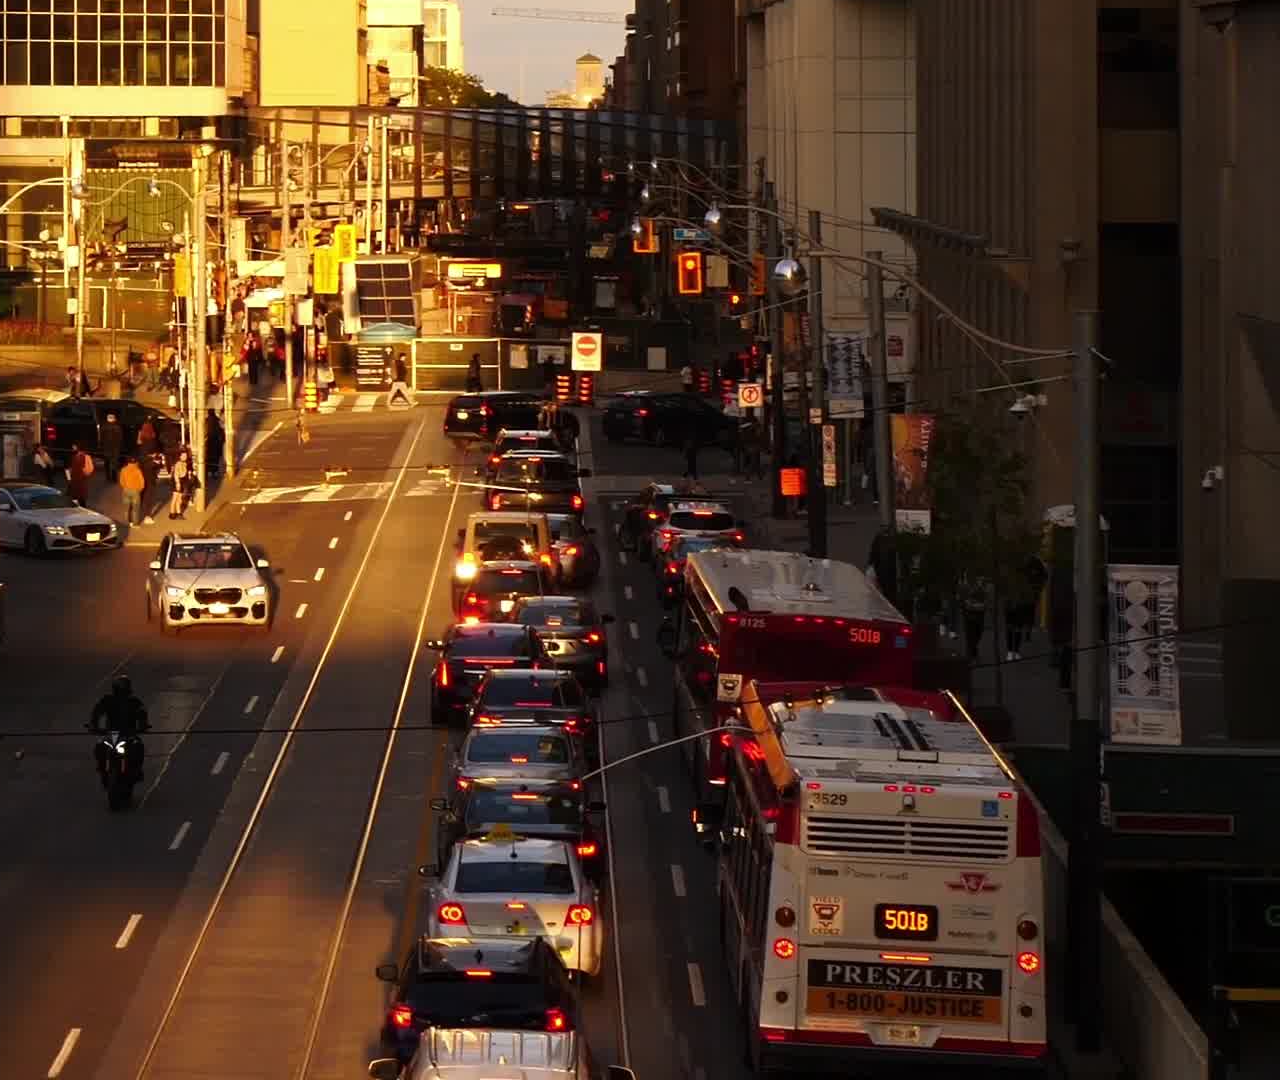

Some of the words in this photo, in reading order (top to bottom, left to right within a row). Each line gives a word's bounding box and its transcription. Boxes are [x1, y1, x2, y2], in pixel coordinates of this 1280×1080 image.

[849, 627, 881, 644] 501B
[812, 793, 847, 806] 3529
[884, 909, 929, 932] 501B
[825, 963, 985, 991] PRESZLER
[825, 992, 984, 1018] 1-800-JUSTICE
